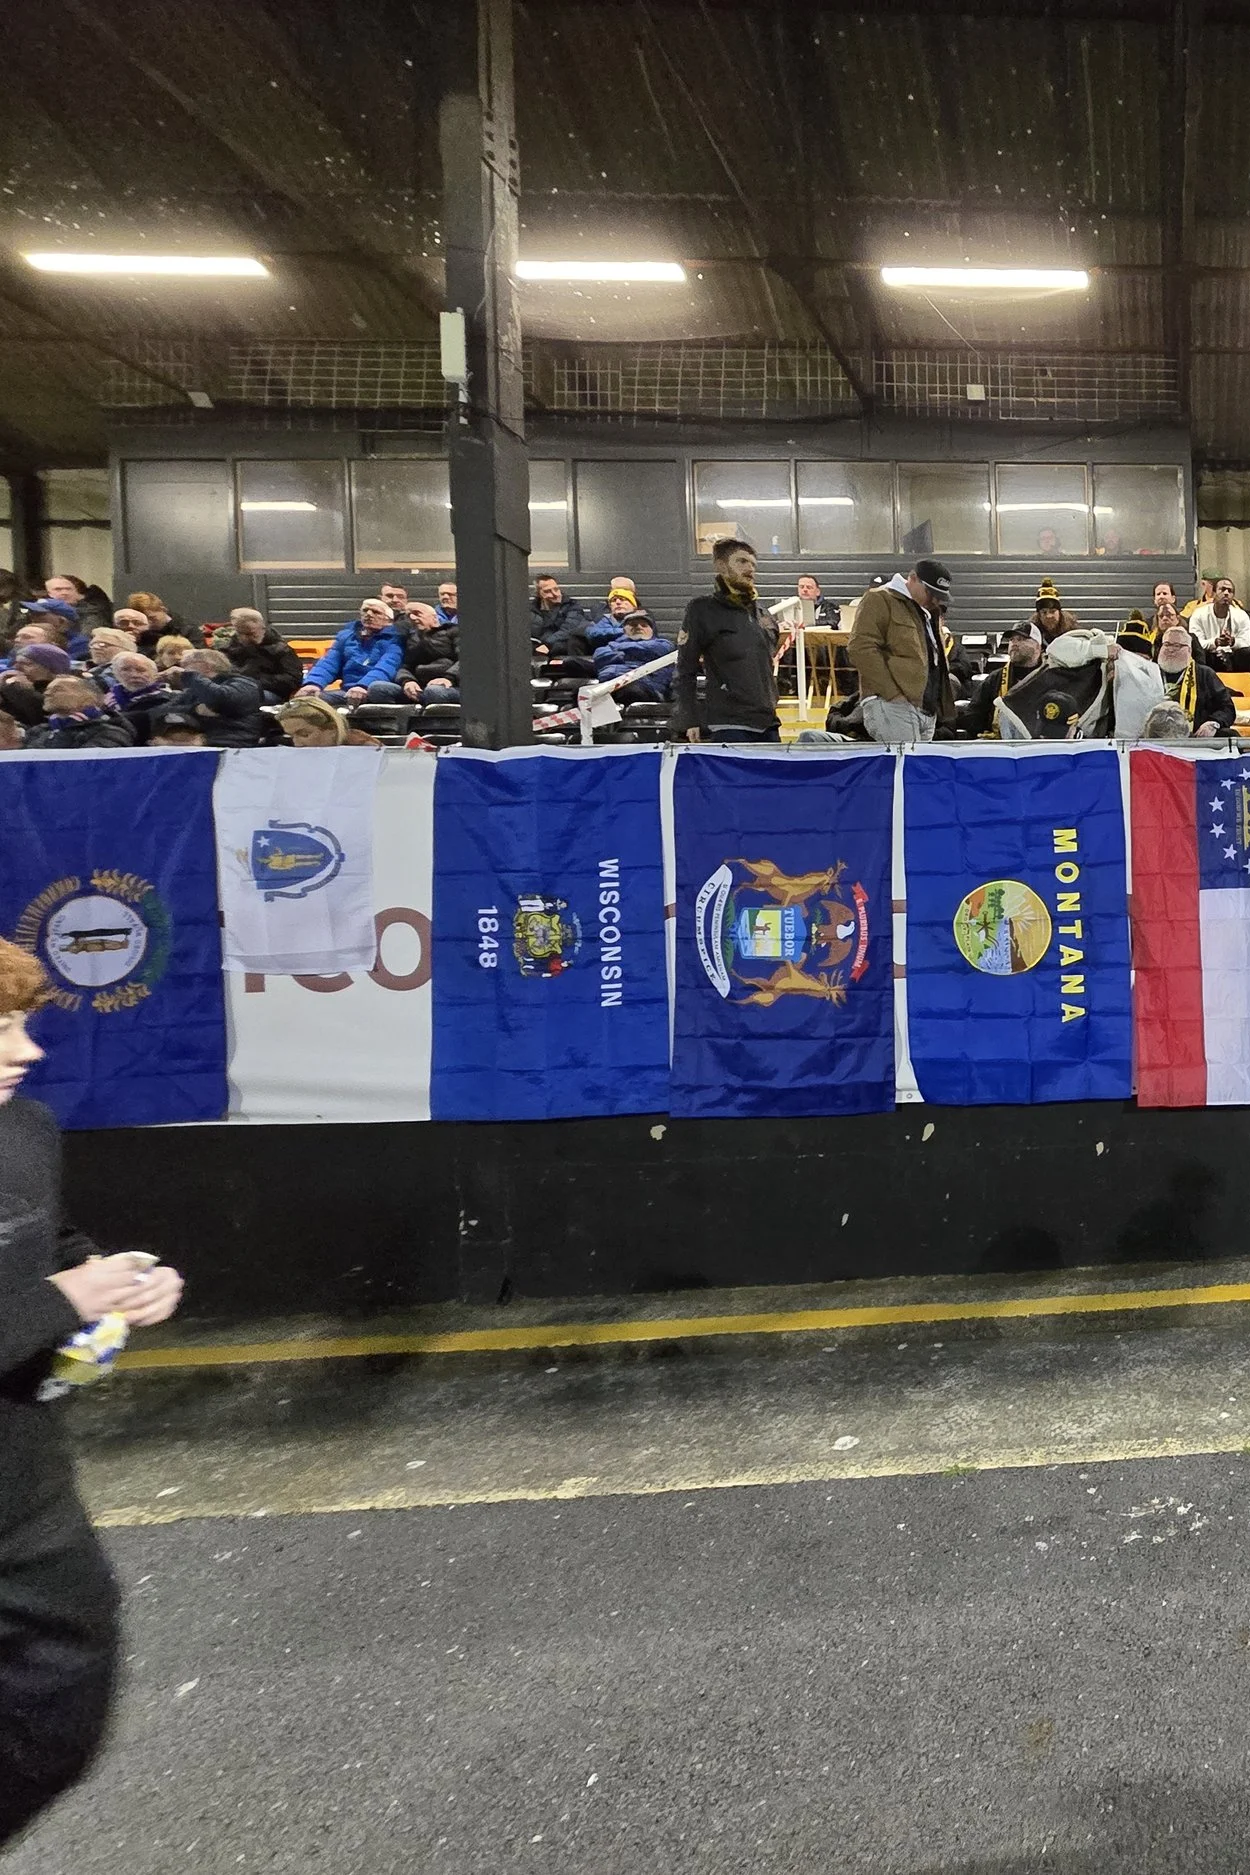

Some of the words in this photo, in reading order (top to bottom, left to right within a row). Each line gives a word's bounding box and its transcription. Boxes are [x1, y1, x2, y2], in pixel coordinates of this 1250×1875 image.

[477, 905, 499, 969] 1848
[598, 858, 623, 1007] WISCONSIN
[697, 882, 716, 981] CIRCUMSPICE
[783, 907, 794, 957] TUEBOR
[1052, 827, 1088, 1023] MONTANA
